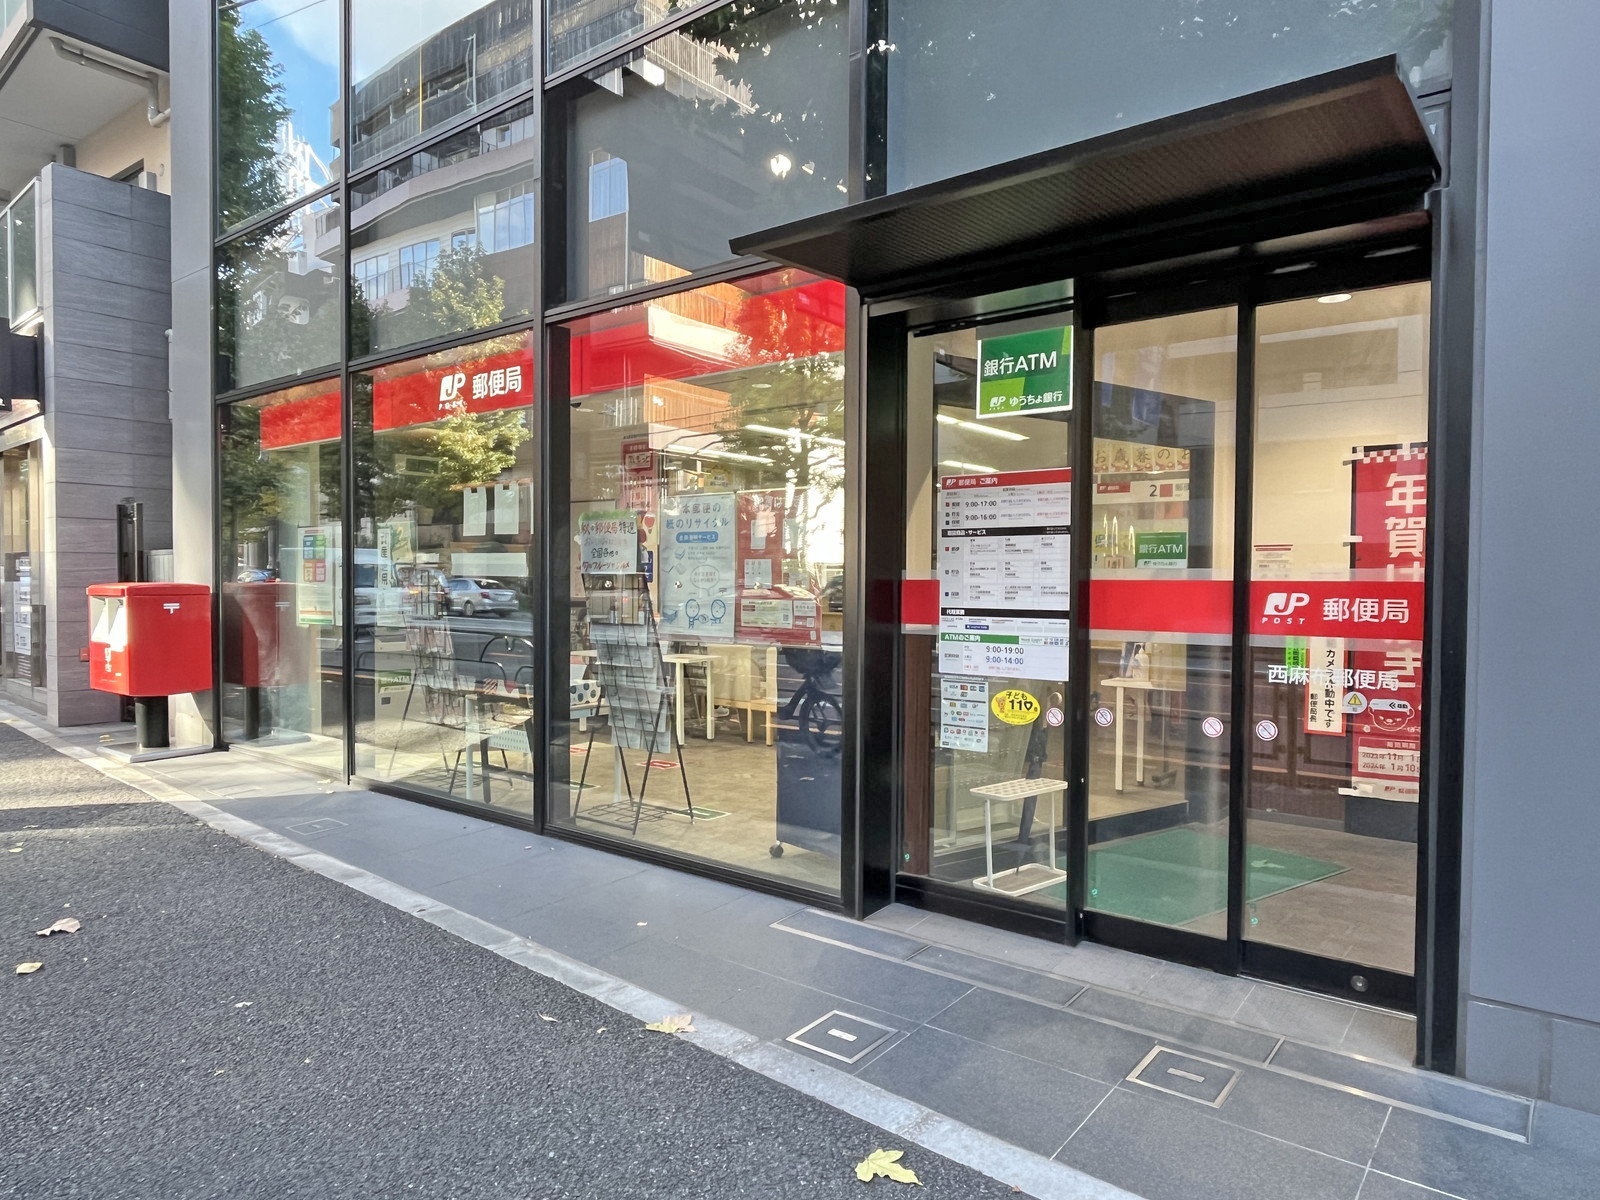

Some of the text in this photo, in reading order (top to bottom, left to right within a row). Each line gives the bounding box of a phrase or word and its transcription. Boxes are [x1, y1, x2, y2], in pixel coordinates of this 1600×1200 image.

[984, 350, 1057, 377] 銀行ATM
[472, 366, 522, 399] 郵便局
[1009, 391, 1063, 407] ゆうちょ銀行
[1149, 484, 1158, 497] 2
[1138, 544, 1183, 554] 銀行ATM
[1322, 597, 1409, 624] 郵便局
[1261, 617, 1305, 625] POST
[986, 645, 1024, 655] 9:00-19:00
[986, 655, 1024, 665] 9:00-14:00
[1006, 691, 1028, 701] 子ども
